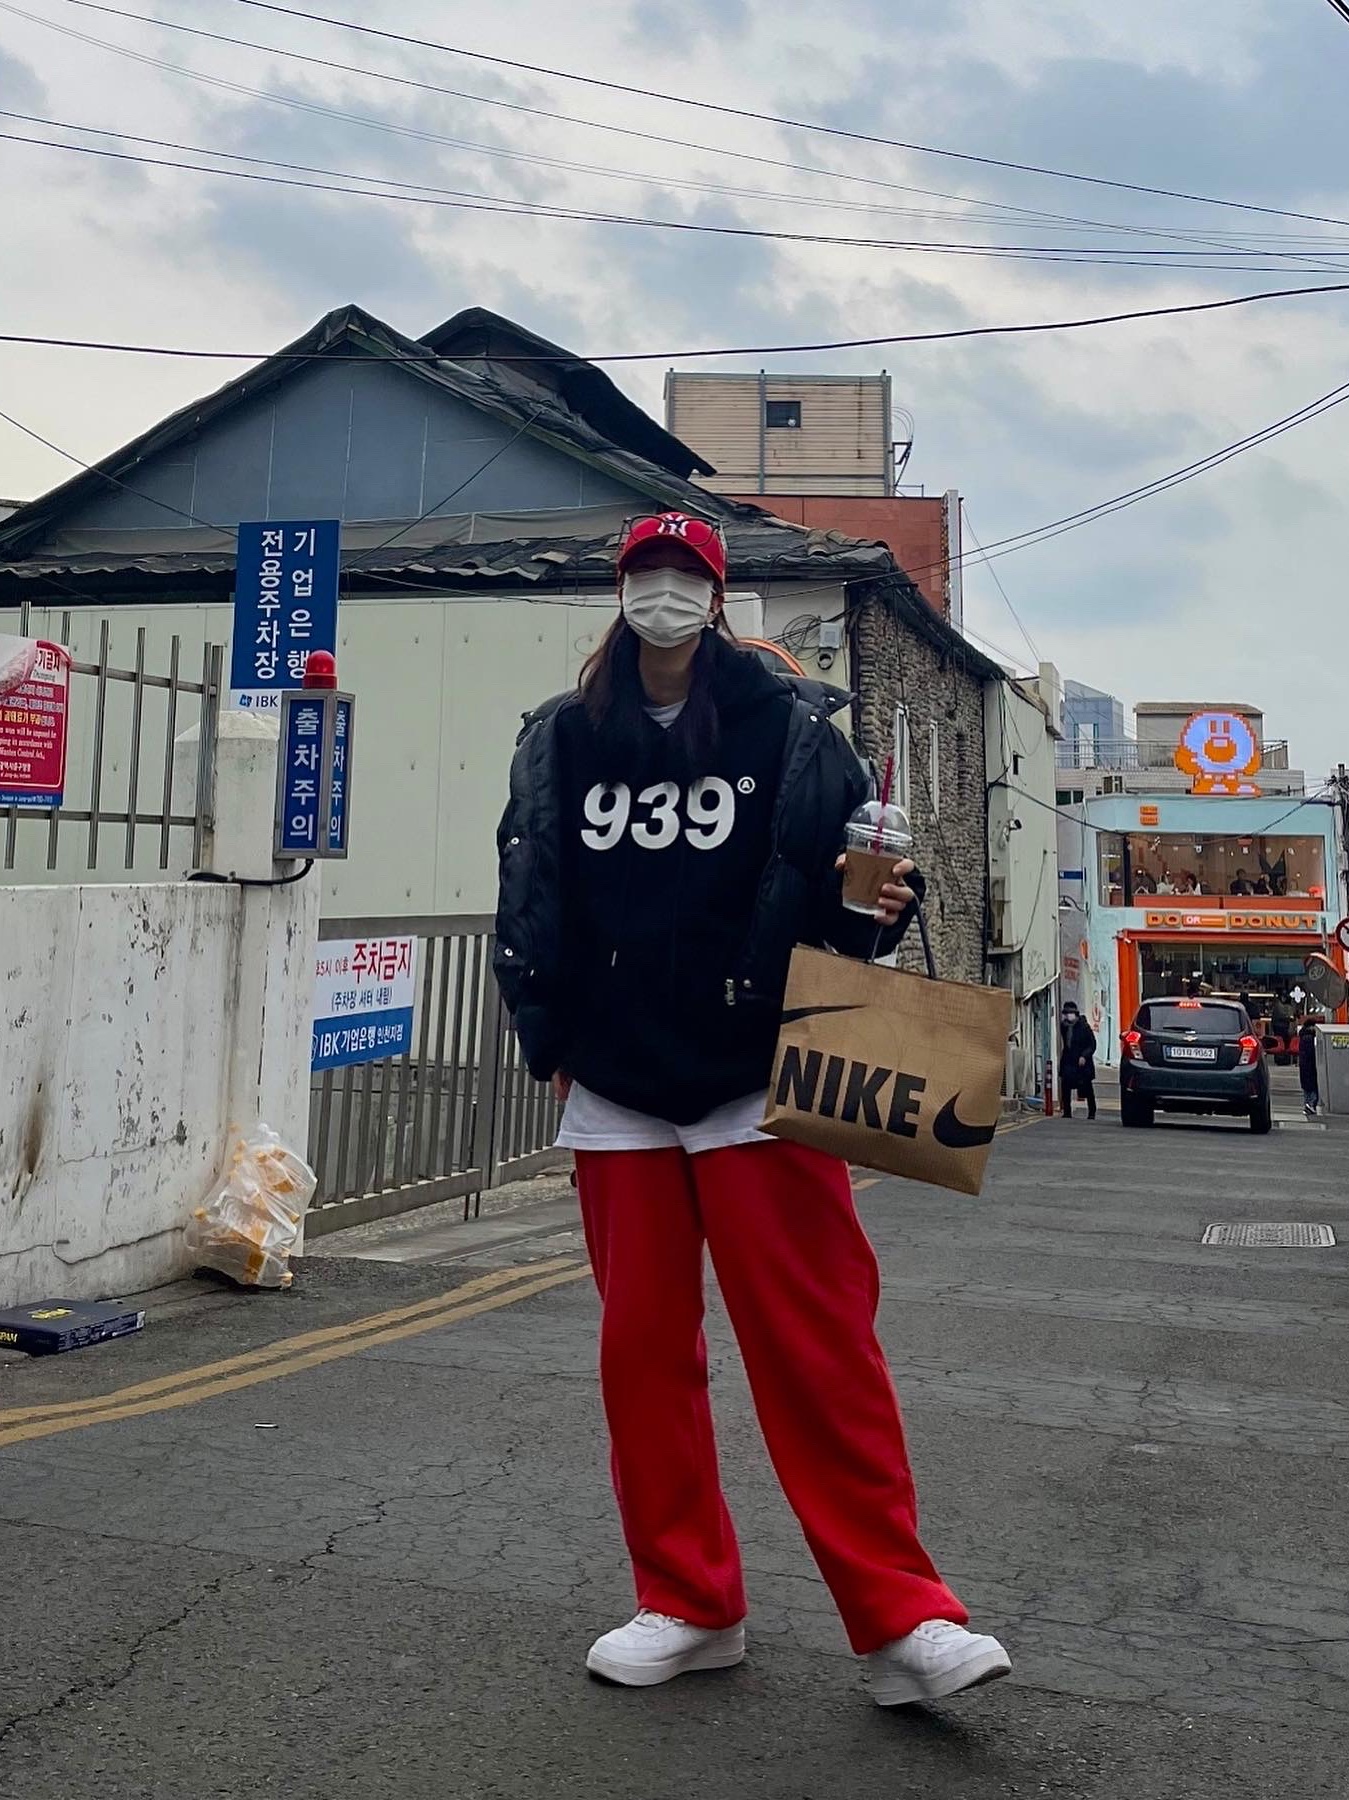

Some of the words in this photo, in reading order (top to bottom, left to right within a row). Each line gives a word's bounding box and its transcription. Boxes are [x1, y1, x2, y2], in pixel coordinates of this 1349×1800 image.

[254, 529, 284, 680] 전용주차장
[287, 528, 316, 679] 기업은행
[256, 696, 279, 708] IBK
[290, 708, 320, 841] 출차주의
[330, 710, 347, 841] 출차주의
[581, 776, 735, 850] 939
[352, 939, 412, 984] 주차금지
[1147, 913, 1180, 927] DO
[1185, 916, 1201, 925] OR
[1229, 914, 1316, 930] DONUT
[319, 1030, 340, 1057] IBK
[340, 1025, 376, 1052] 기업은행
[775, 1044, 927, 1139] NIKE
